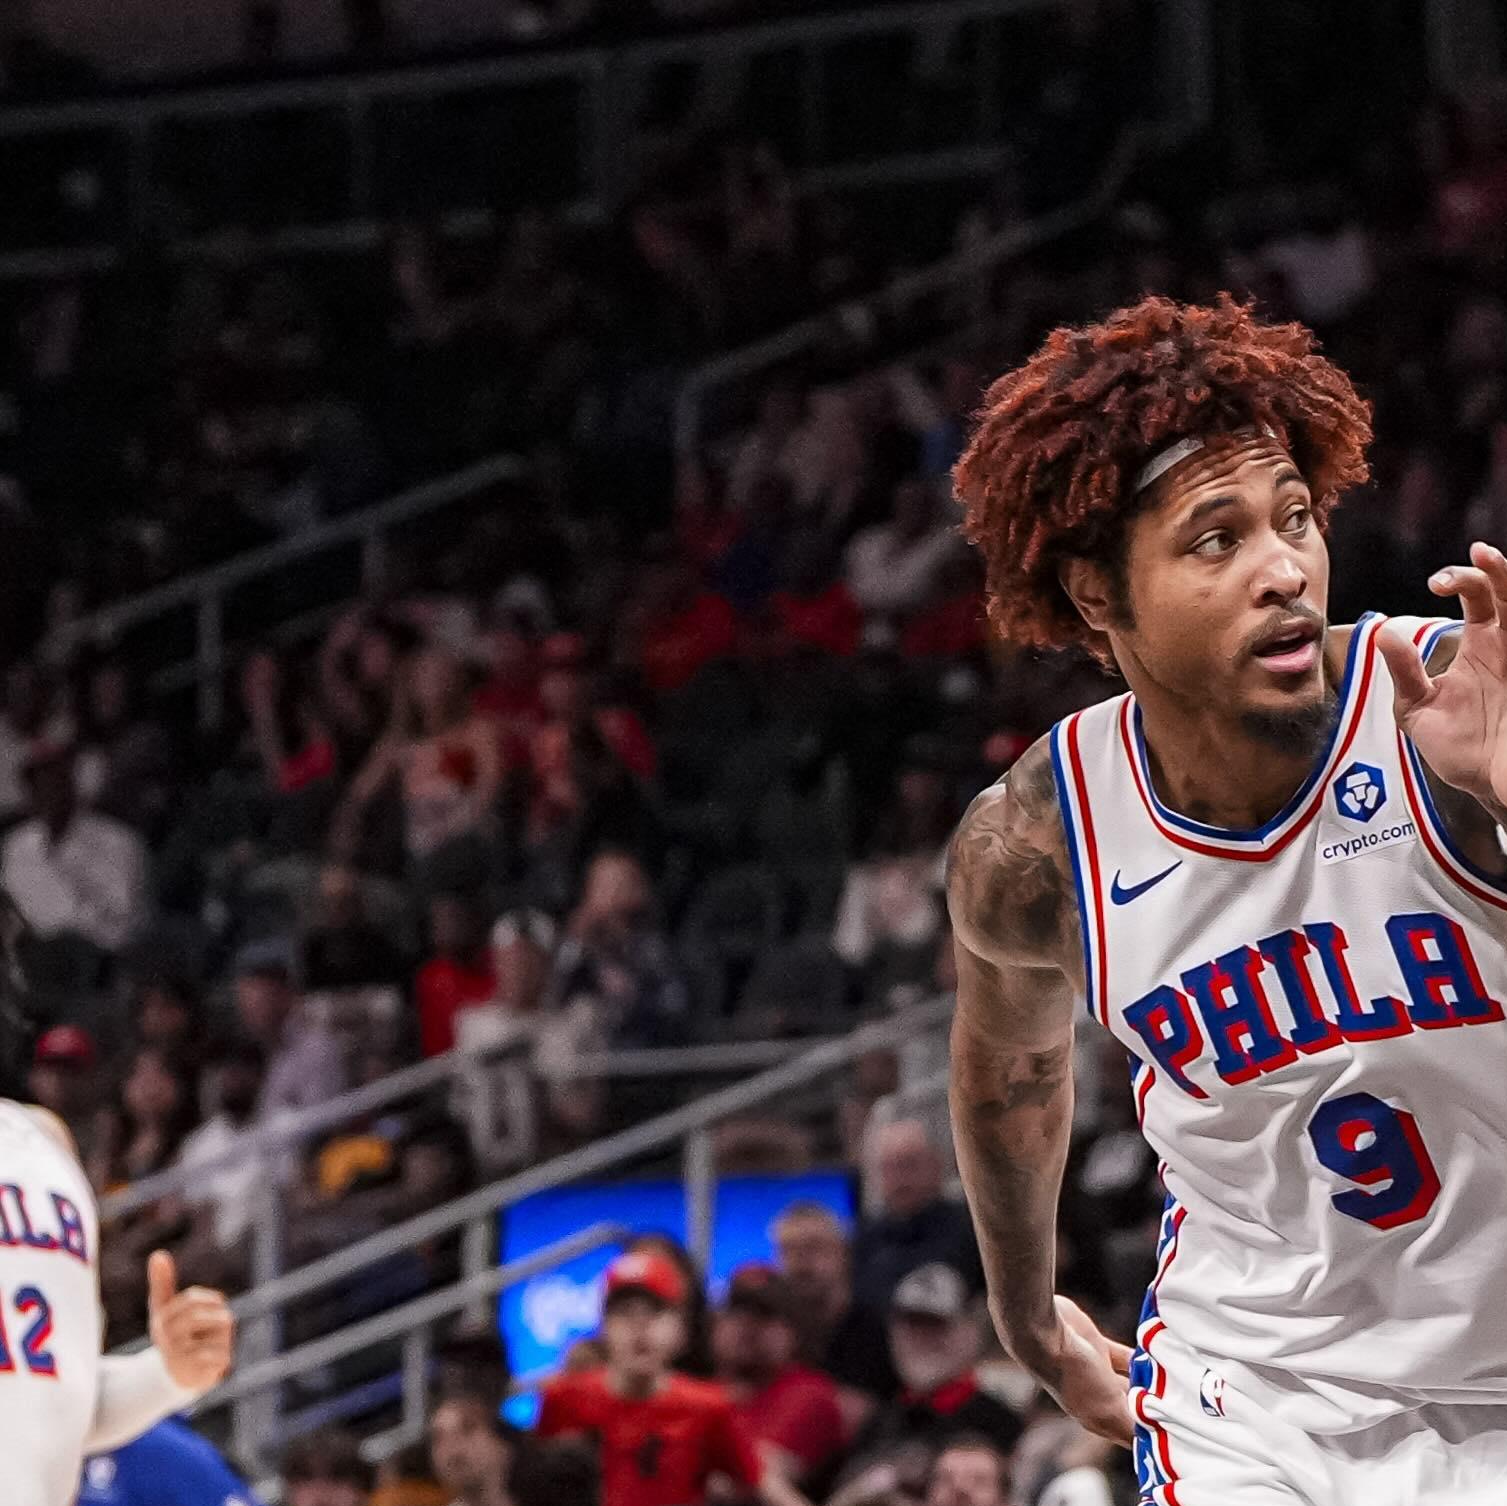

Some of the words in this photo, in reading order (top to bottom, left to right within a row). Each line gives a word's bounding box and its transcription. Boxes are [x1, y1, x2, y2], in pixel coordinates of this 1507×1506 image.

[1323, 822, 1416, 860] crypto.com
[1121, 912, 1506, 1100] PHILA
[1307, 1091, 1442, 1232] 9
